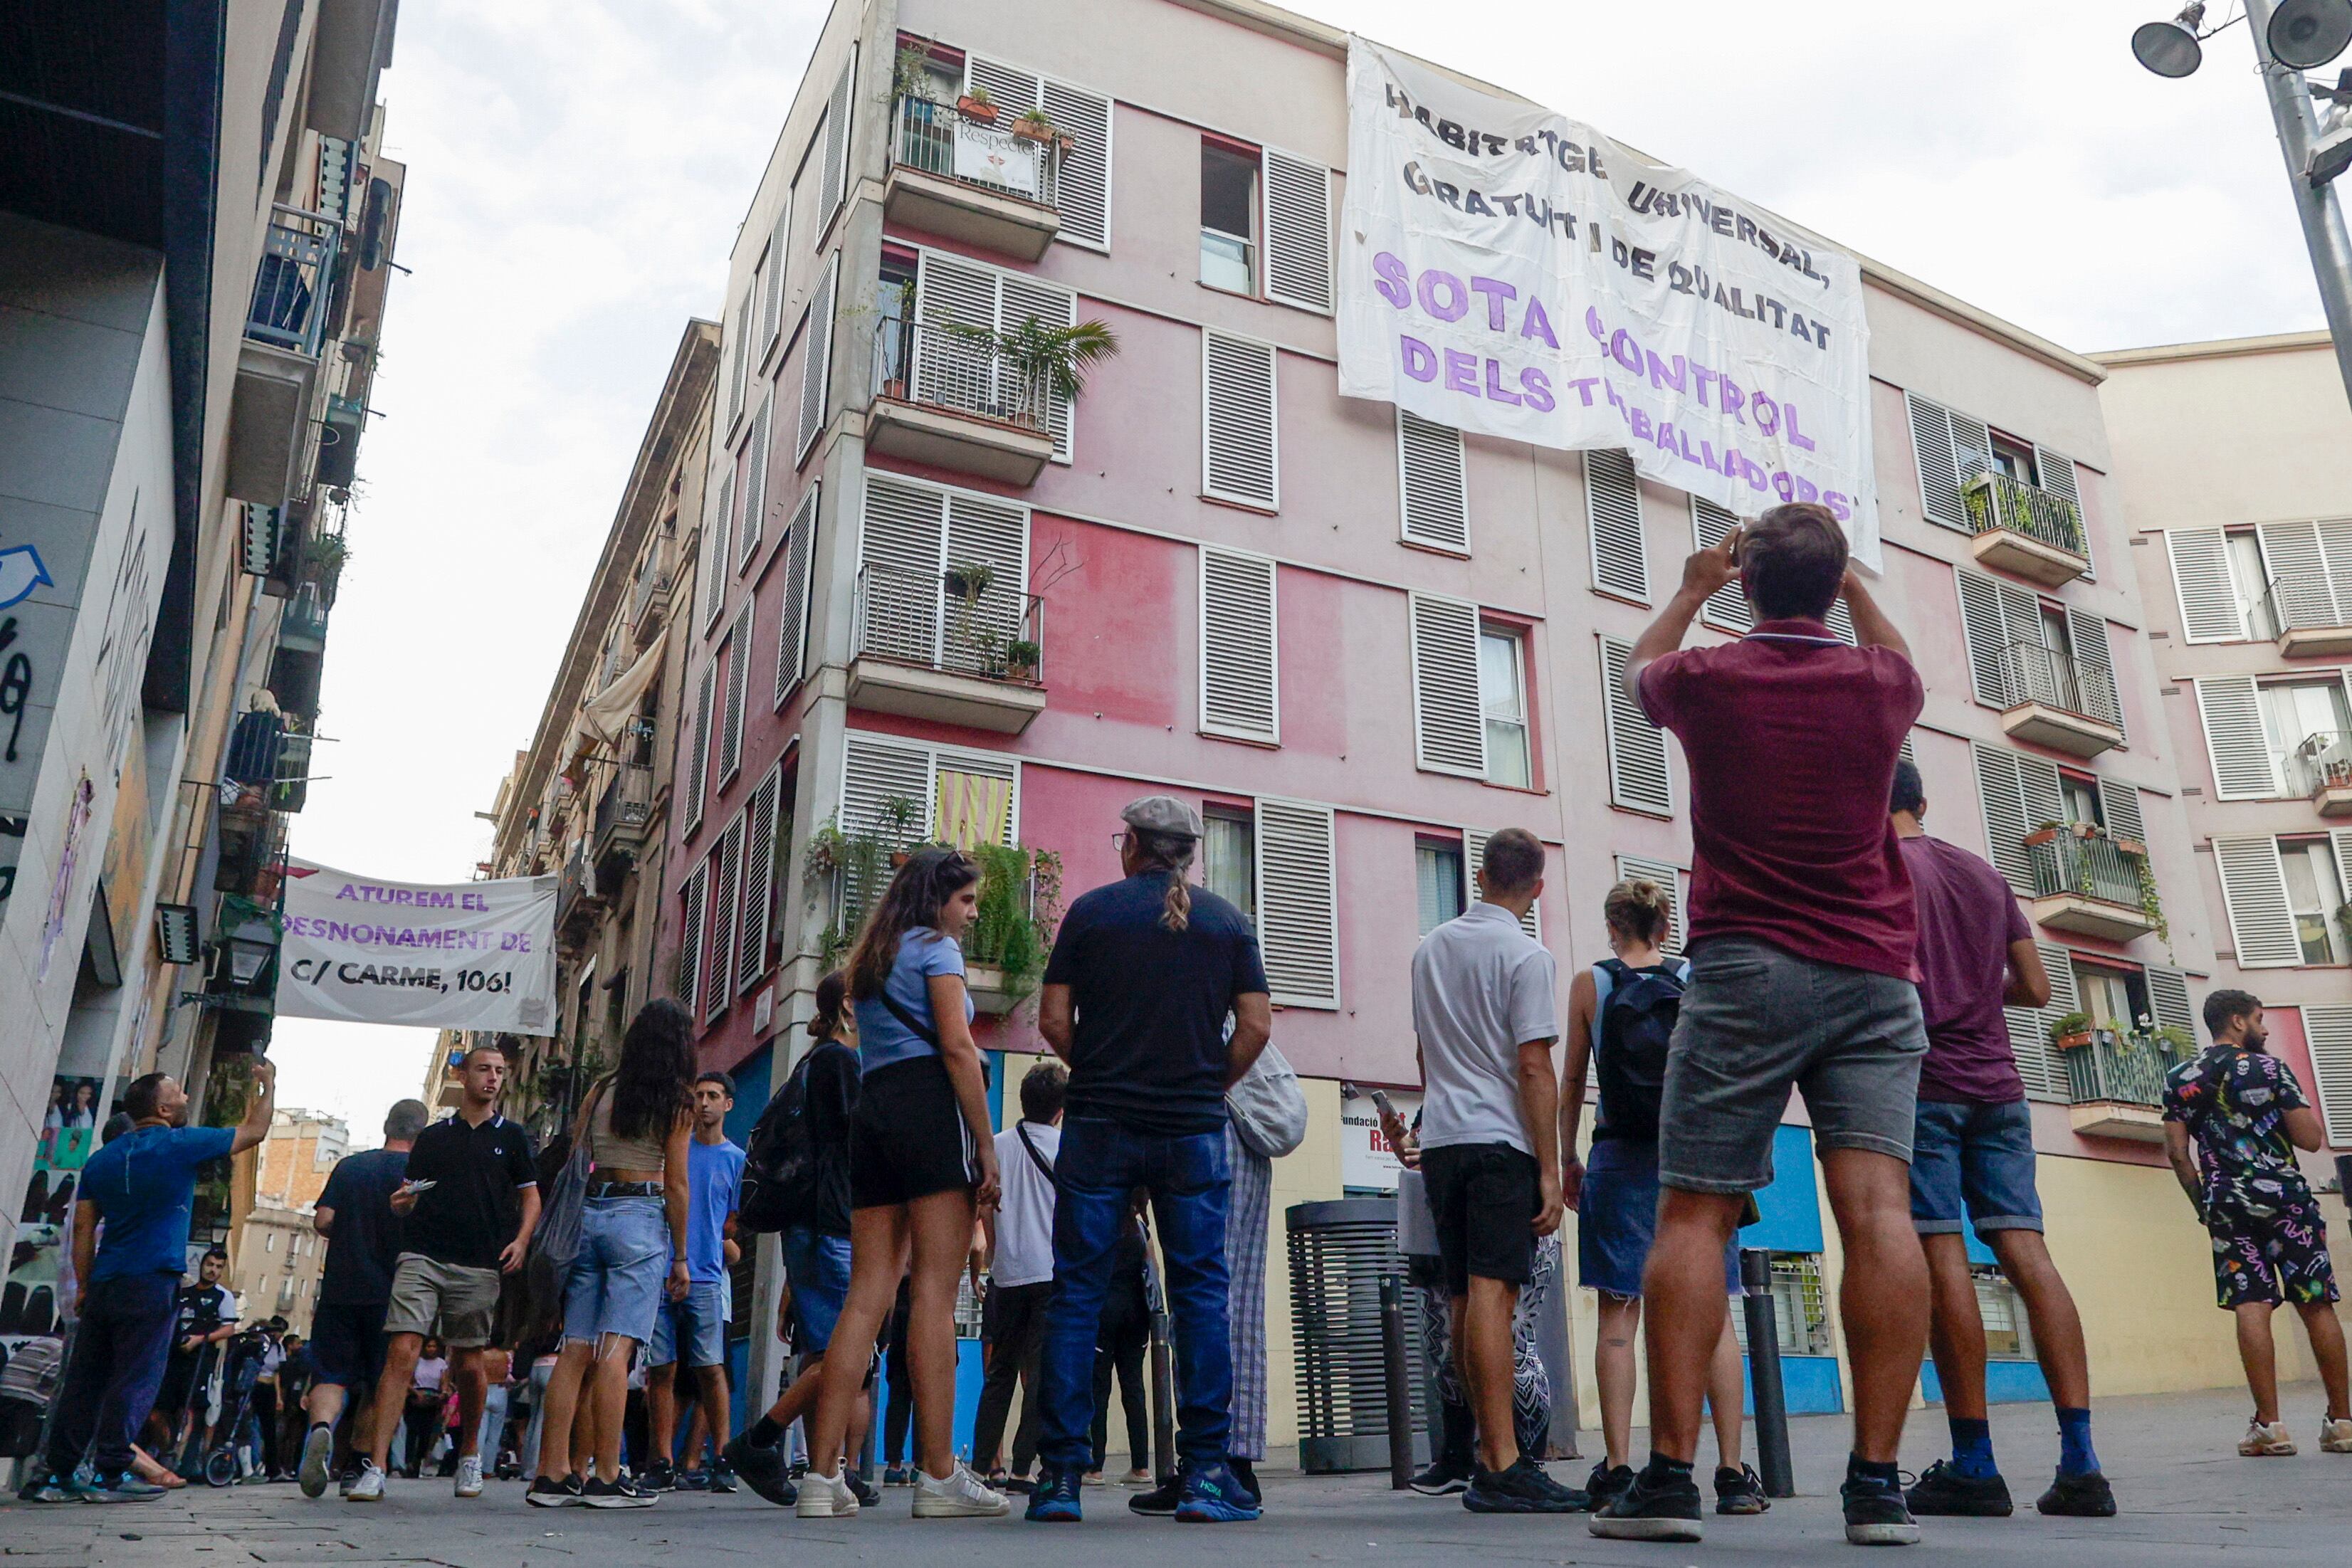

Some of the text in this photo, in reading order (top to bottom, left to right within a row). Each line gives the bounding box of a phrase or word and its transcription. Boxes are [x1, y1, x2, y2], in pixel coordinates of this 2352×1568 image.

[960, 124, 1032, 156] Respecte
[1403, 160, 1831, 351] GRATUIT I DE QUALITAT
[1627, 181, 1831, 290] UNIVERSAL,
[1372, 251, 1816, 452] SOTA CONTROL
[1400, 334, 1556, 414] DELS
[335, 883, 490, 912] ATUREM EL
[500, 930, 532, 953] DE
[290, 959, 513, 994] C/ CARME, 106!
